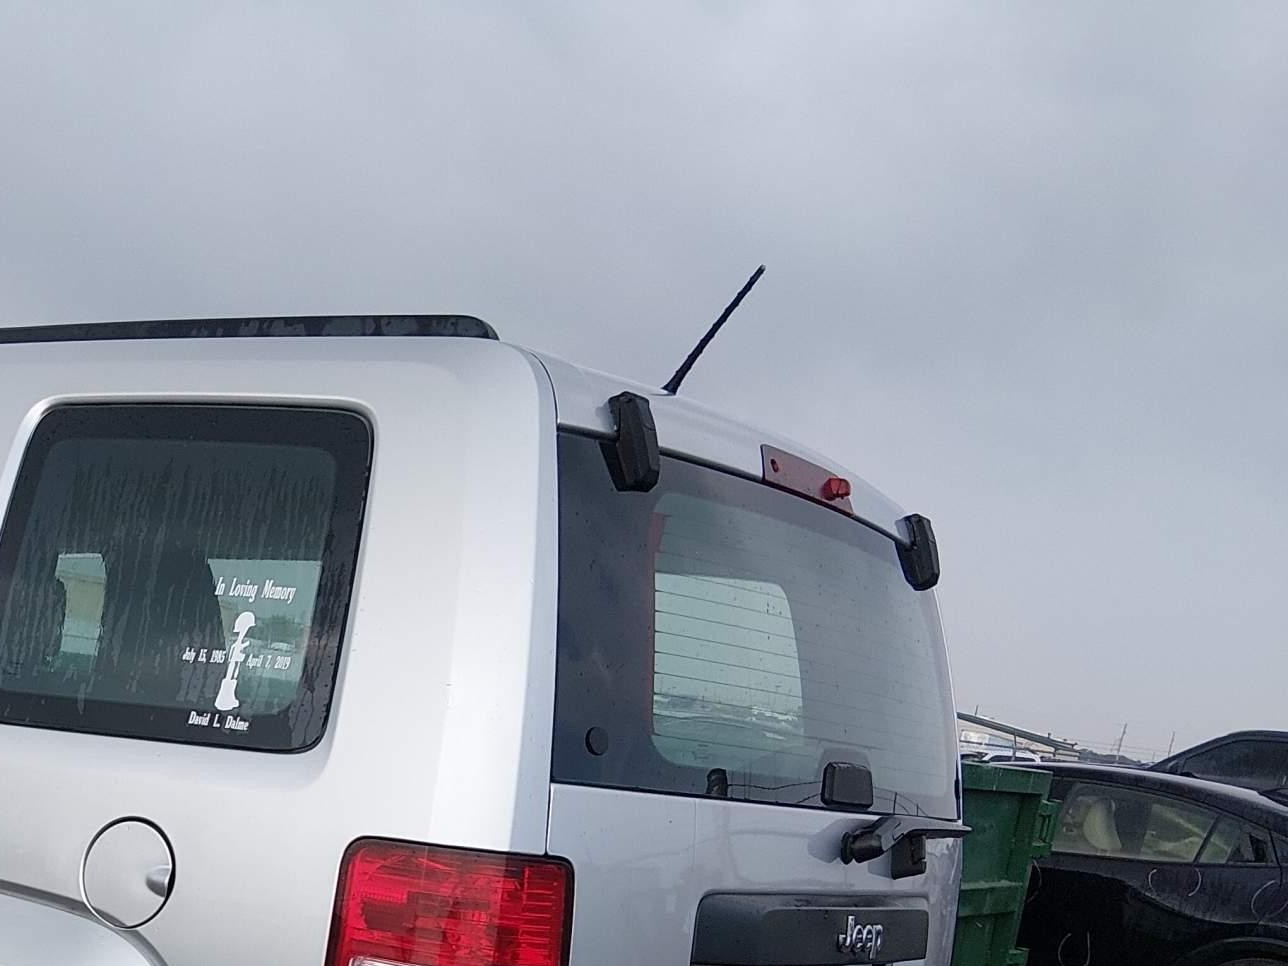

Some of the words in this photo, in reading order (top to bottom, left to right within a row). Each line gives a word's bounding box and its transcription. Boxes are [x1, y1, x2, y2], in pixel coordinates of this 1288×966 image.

[214, 576, 226, 595] In
[229, 577, 258, 603] Loving
[261, 580, 296, 604] Memory
[246, 653, 264, 669] April
[188, 711, 211, 726] David
[838, 915, 883, 959] Jeep
